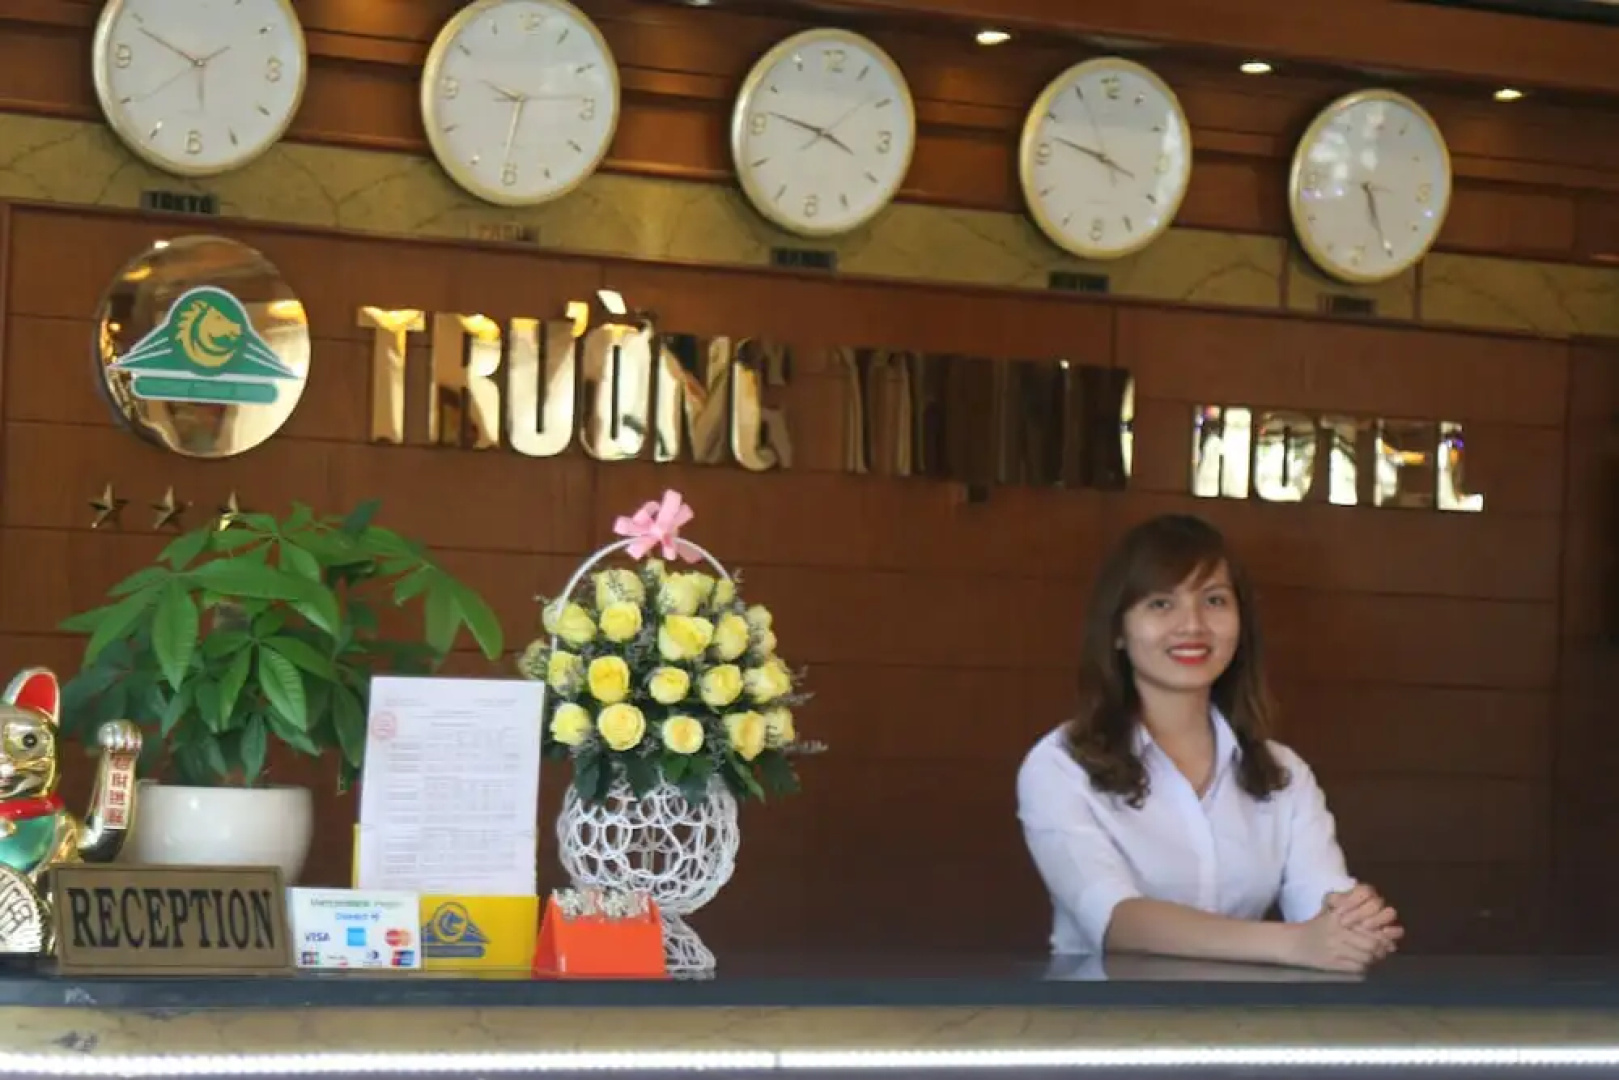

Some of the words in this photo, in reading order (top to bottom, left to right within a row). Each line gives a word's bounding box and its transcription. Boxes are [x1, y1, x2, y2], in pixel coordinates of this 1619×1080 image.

[116, 44, 132, 69] 9
[823, 49, 846, 74] 12
[186, 129, 202, 155] 6
[876, 130, 892, 154] 3
[356, 288, 793, 471] TRƯỜNG
[1192, 404, 1484, 512] HOTEL
[66, 886, 275, 949] RECEPTION
[305, 931, 331, 942] VISA
